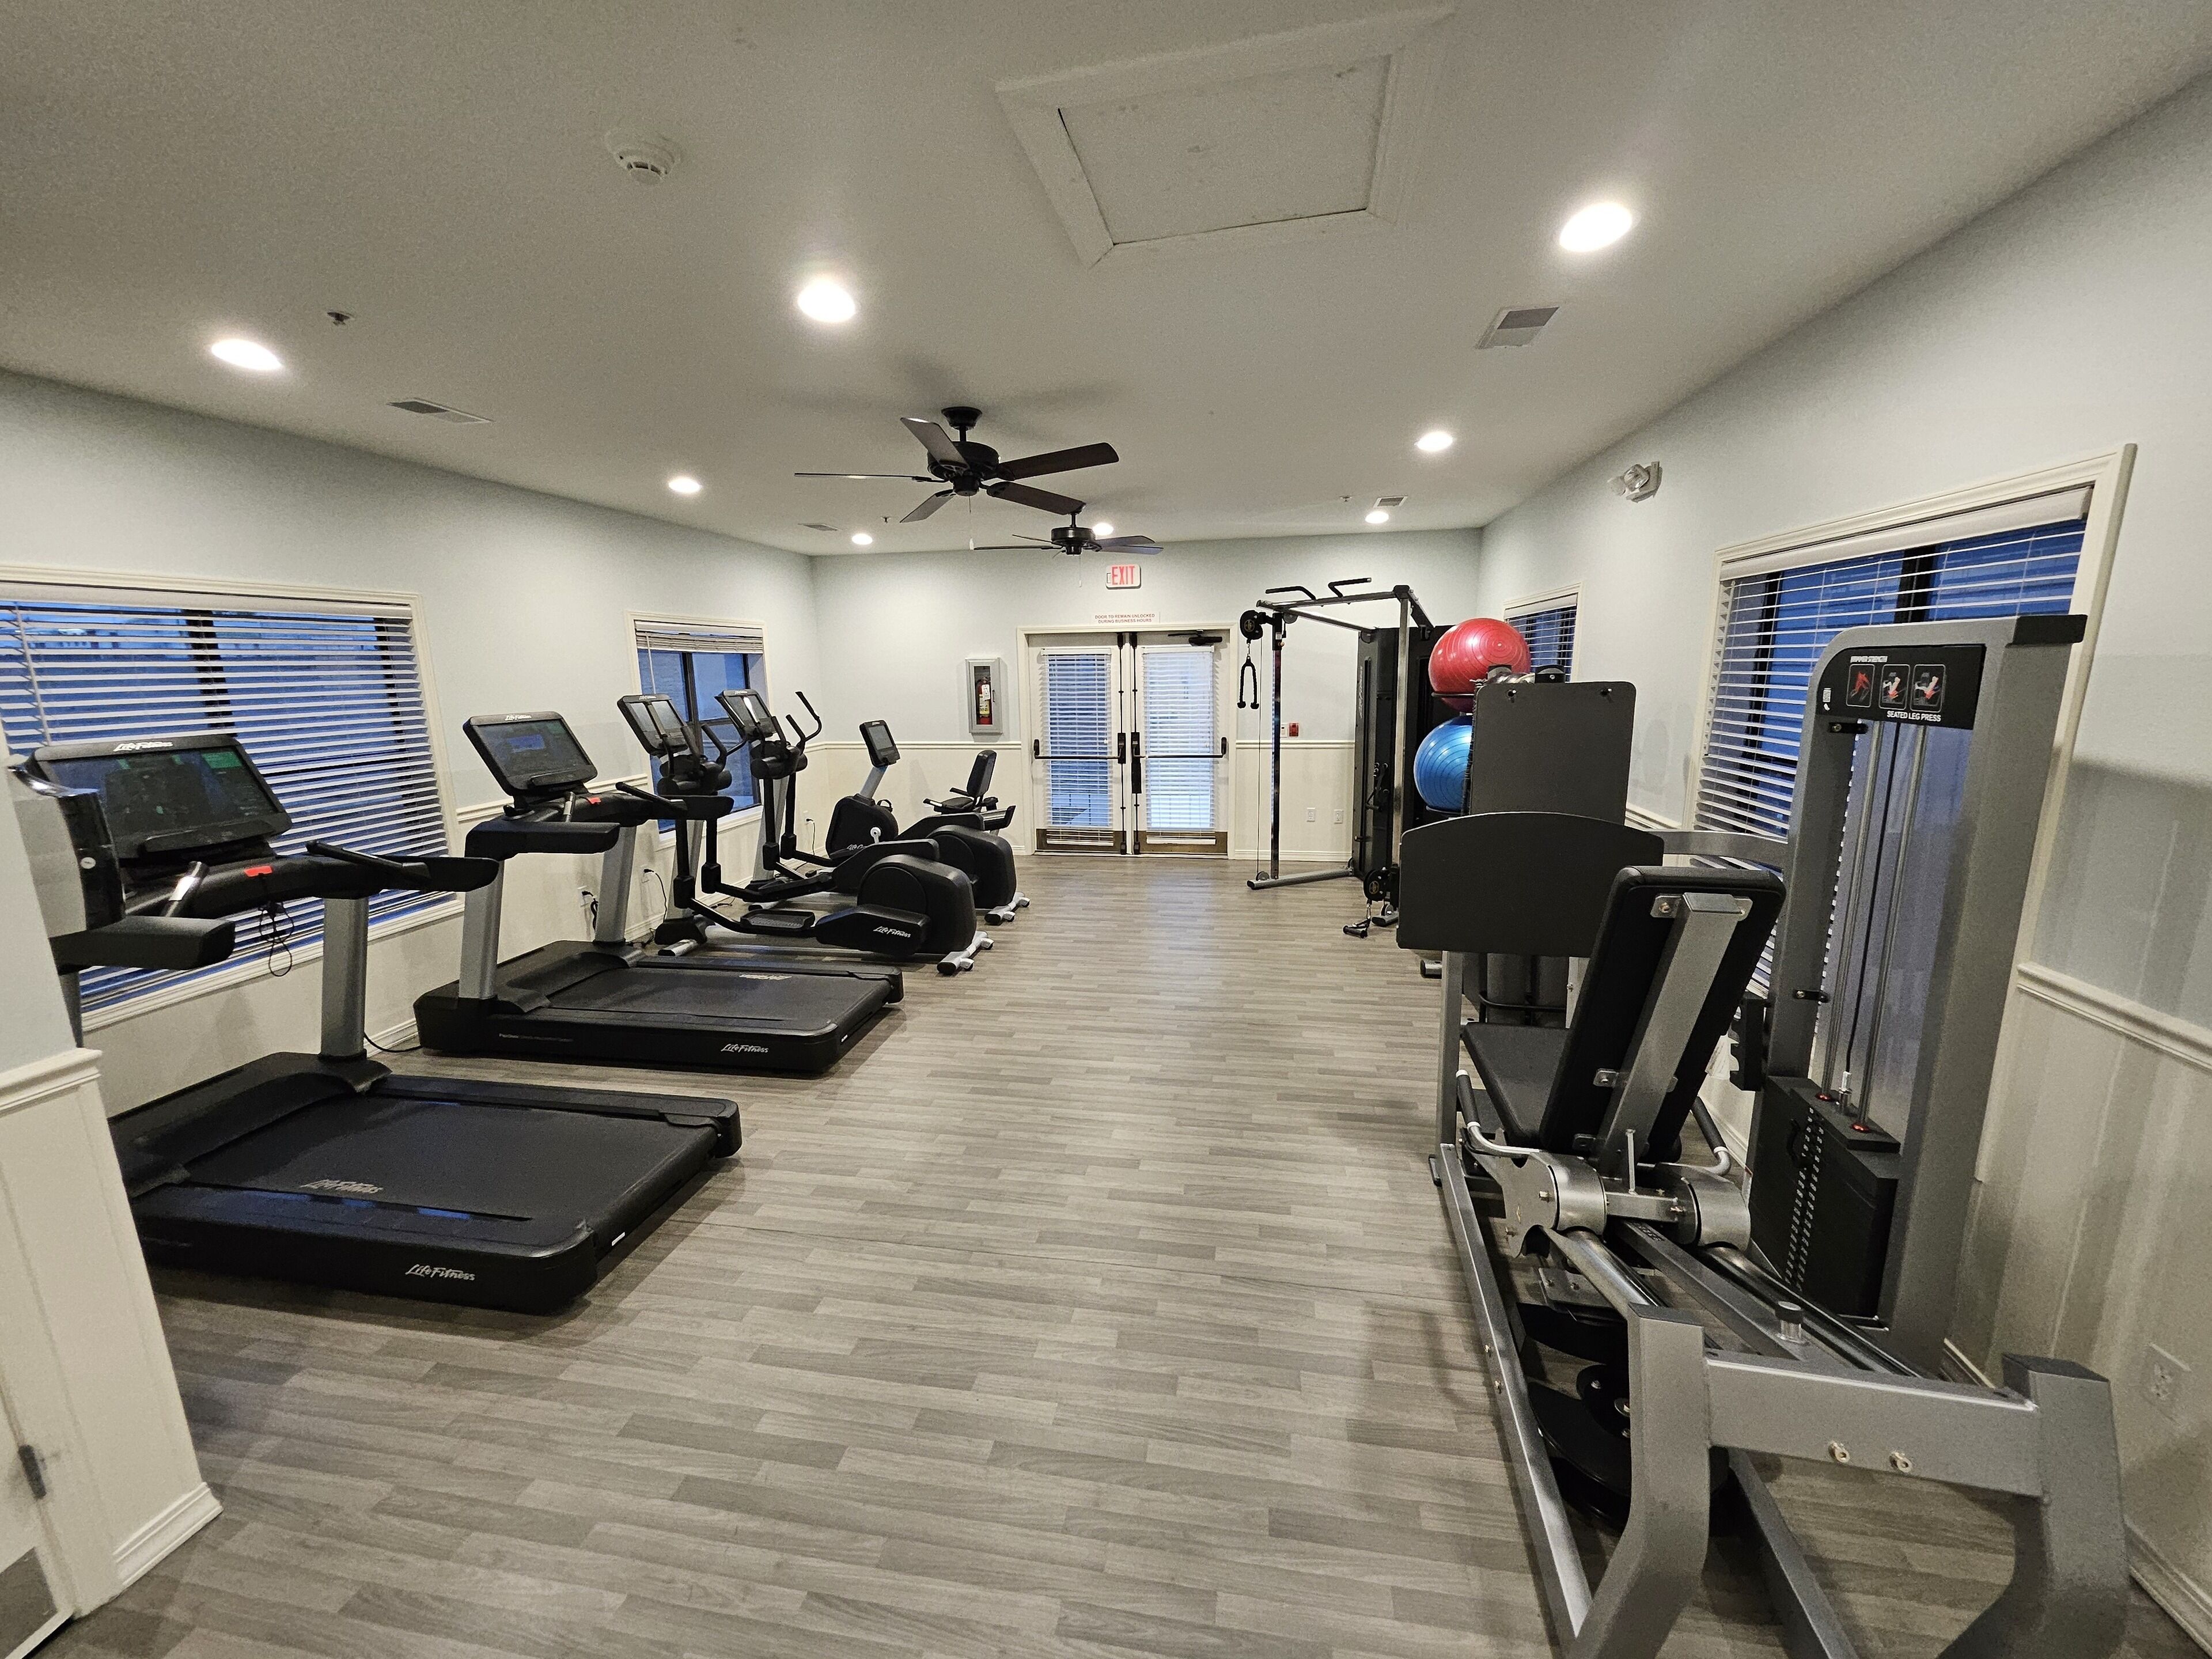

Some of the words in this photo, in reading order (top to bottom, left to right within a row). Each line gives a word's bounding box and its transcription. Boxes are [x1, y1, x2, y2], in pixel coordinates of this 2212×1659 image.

[1112, 566, 1135, 585] EXIT
[1887, 710, 1908, 719] SEATED
[1908, 712, 1921, 720] LEG
[1920, 713, 1941, 722] PRESS
